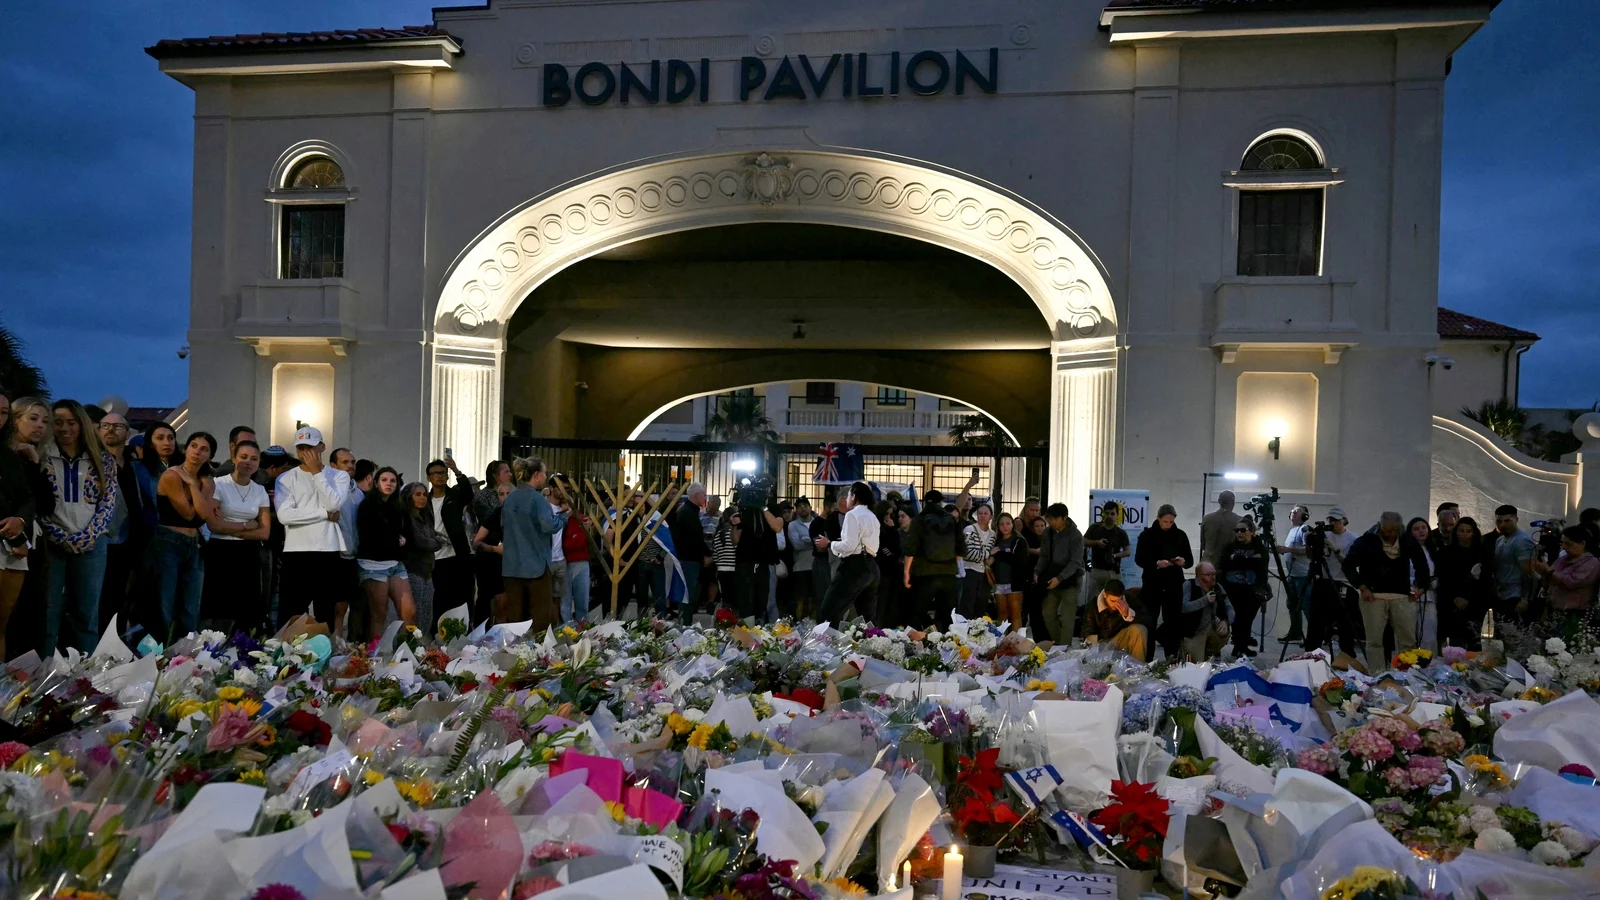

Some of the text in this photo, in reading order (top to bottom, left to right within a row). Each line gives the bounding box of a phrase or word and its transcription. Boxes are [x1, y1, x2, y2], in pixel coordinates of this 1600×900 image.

[543, 47, 999, 106] BONDI PAVILION
[1094, 506, 1144, 525] BNDI
